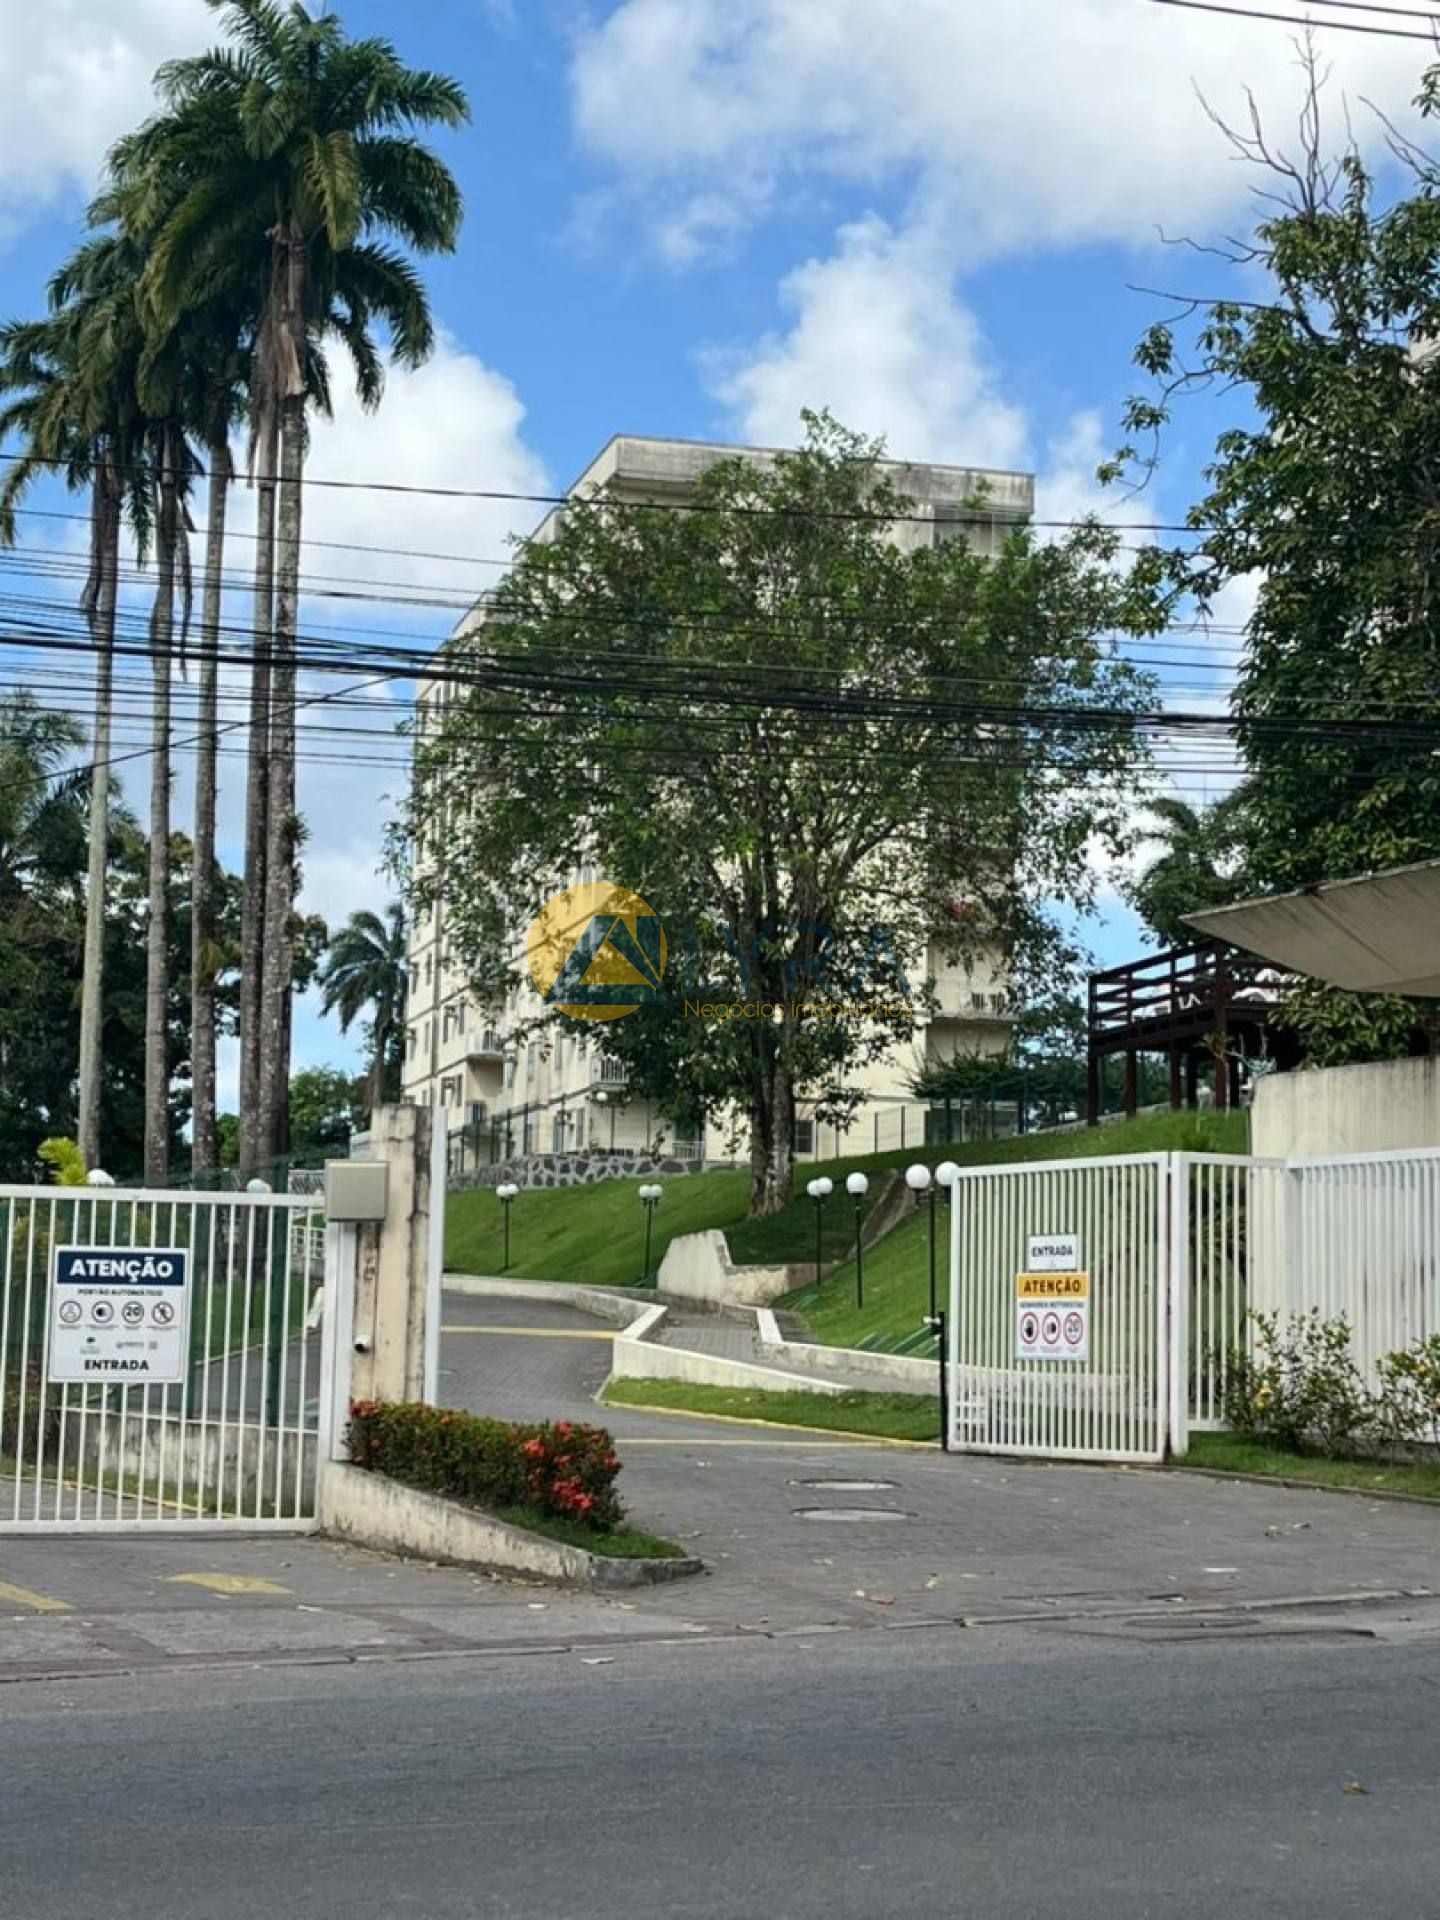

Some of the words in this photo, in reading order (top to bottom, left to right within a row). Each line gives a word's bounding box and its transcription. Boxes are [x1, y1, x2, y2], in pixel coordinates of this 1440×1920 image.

[1032, 1246, 1073, 1257] ENTRADA
[70, 1257, 173, 1283] ATENÇÃO
[1023, 1277, 1081, 1296] ATENÇÃO
[125, 1304, 141, 1317] 20
[84, 1359, 149, 1370] ENTRADA
